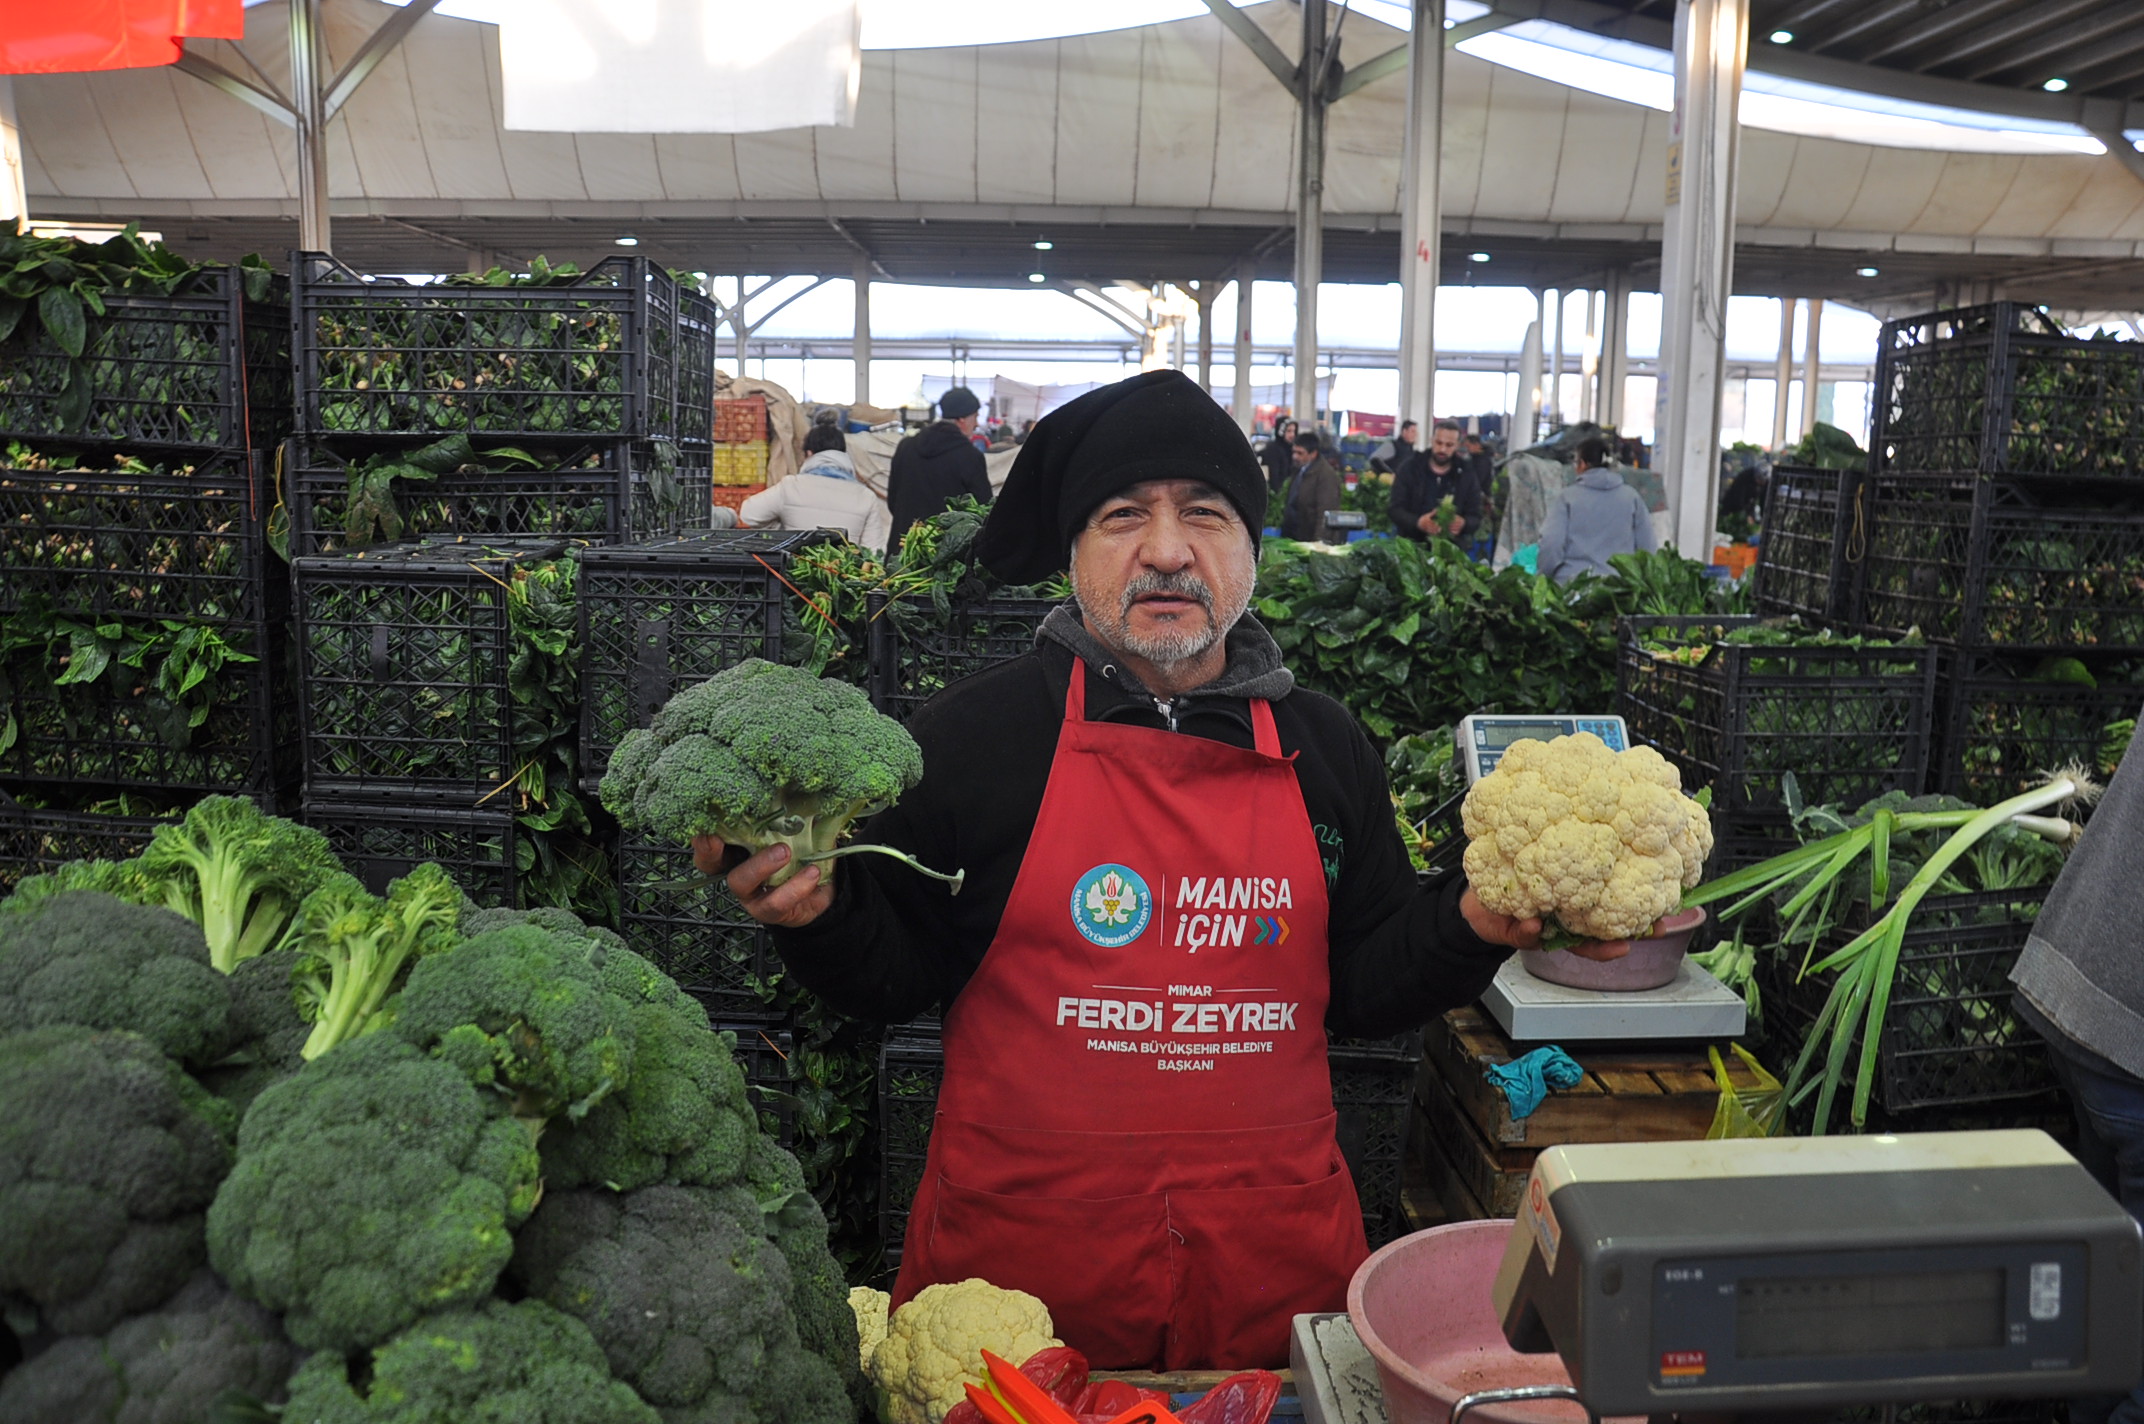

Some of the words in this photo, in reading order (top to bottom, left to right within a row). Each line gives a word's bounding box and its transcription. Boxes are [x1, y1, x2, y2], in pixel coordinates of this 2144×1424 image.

[1175, 876, 1293, 909] MANİSA
[1174, 913, 1248, 954] İÇİN
[1056, 996, 1164, 1032] FERDİ
[1171, 1002, 1299, 1033] ZEYREK
[1140, 1040, 1220, 1057] BÜYÜKŞEHİR
[1157, 1059, 1214, 1073] BAŞKANI
